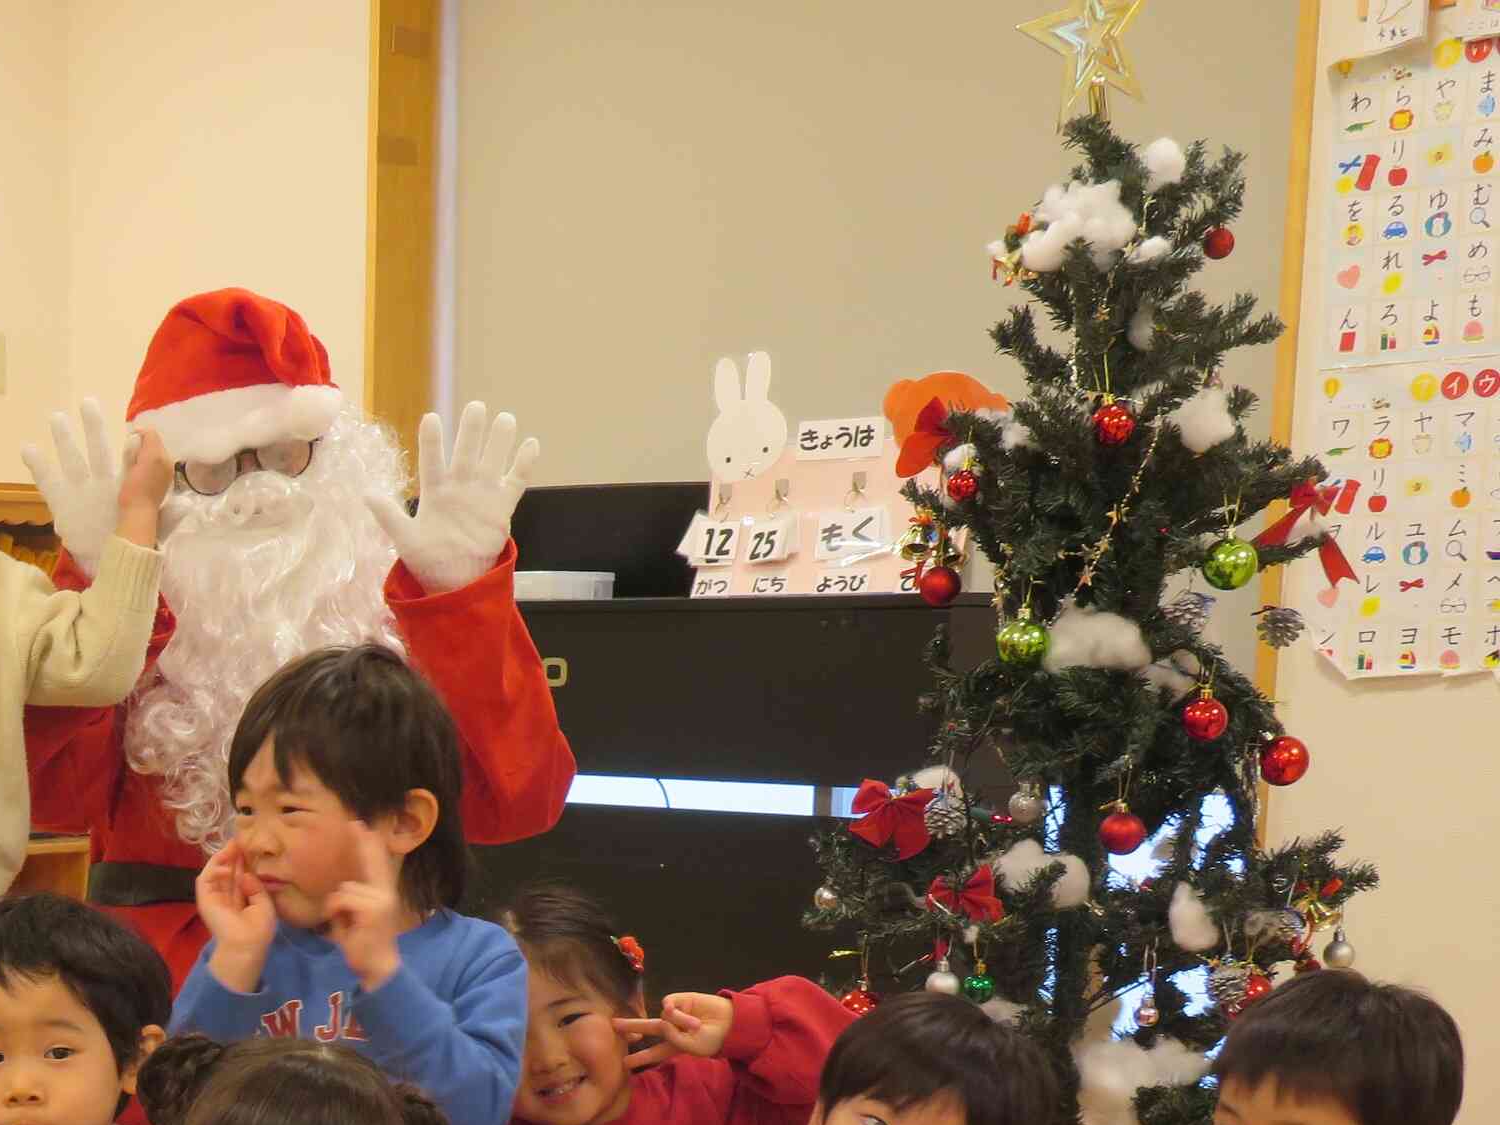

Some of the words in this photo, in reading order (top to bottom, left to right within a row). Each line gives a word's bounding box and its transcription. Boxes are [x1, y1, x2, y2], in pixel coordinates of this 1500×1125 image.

[1436, 80, 1457, 98] や
[1480, 70, 1495, 93] ま
[1350, 91, 1371, 112] わ
[1396, 85, 1411, 106] ら
[1473, 128, 1492, 147] み
[1392, 139, 1405, 161] り
[1429, 190, 1448, 208] ゆ
[1473, 184, 1492, 206] む
[1348, 200, 1362, 221] を
[1388, 194, 1404, 216] る
[1468, 241, 1487, 258] め
[1381, 250, 1403, 270] れ
[1381, 304, 1398, 326] ろ
[1423, 300, 1439, 321] よ
[1469, 294, 1482, 317] も
[1340, 307, 1358, 330] ん
[1332, 419, 1350, 438] ワ
[1373, 416, 1390, 434] ラ
[1414, 411, 1433, 432] ヤ
[1455, 411, 1475, 427] マ
[799, 424, 875, 451] きょうは
[1458, 464, 1466, 482] ミ
[1366, 522, 1385, 540] ル
[1405, 523, 1426, 536] ユ
[1448, 519, 1467, 536] ム
[704, 528, 733, 556] 12
[750, 530, 778, 560] 25
[821, 516, 874, 552] もく
[696, 579, 727, 595] がつ
[753, 576, 787, 593] にち
[816, 574, 867, 592] ようび
[1366, 574, 1380, 593] レ
[1445, 572, 1462, 591] メ
[1358, 631, 1376, 643] ロ
[1401, 628, 1417, 644] ヨ
[1441, 627, 1462, 645] モ
